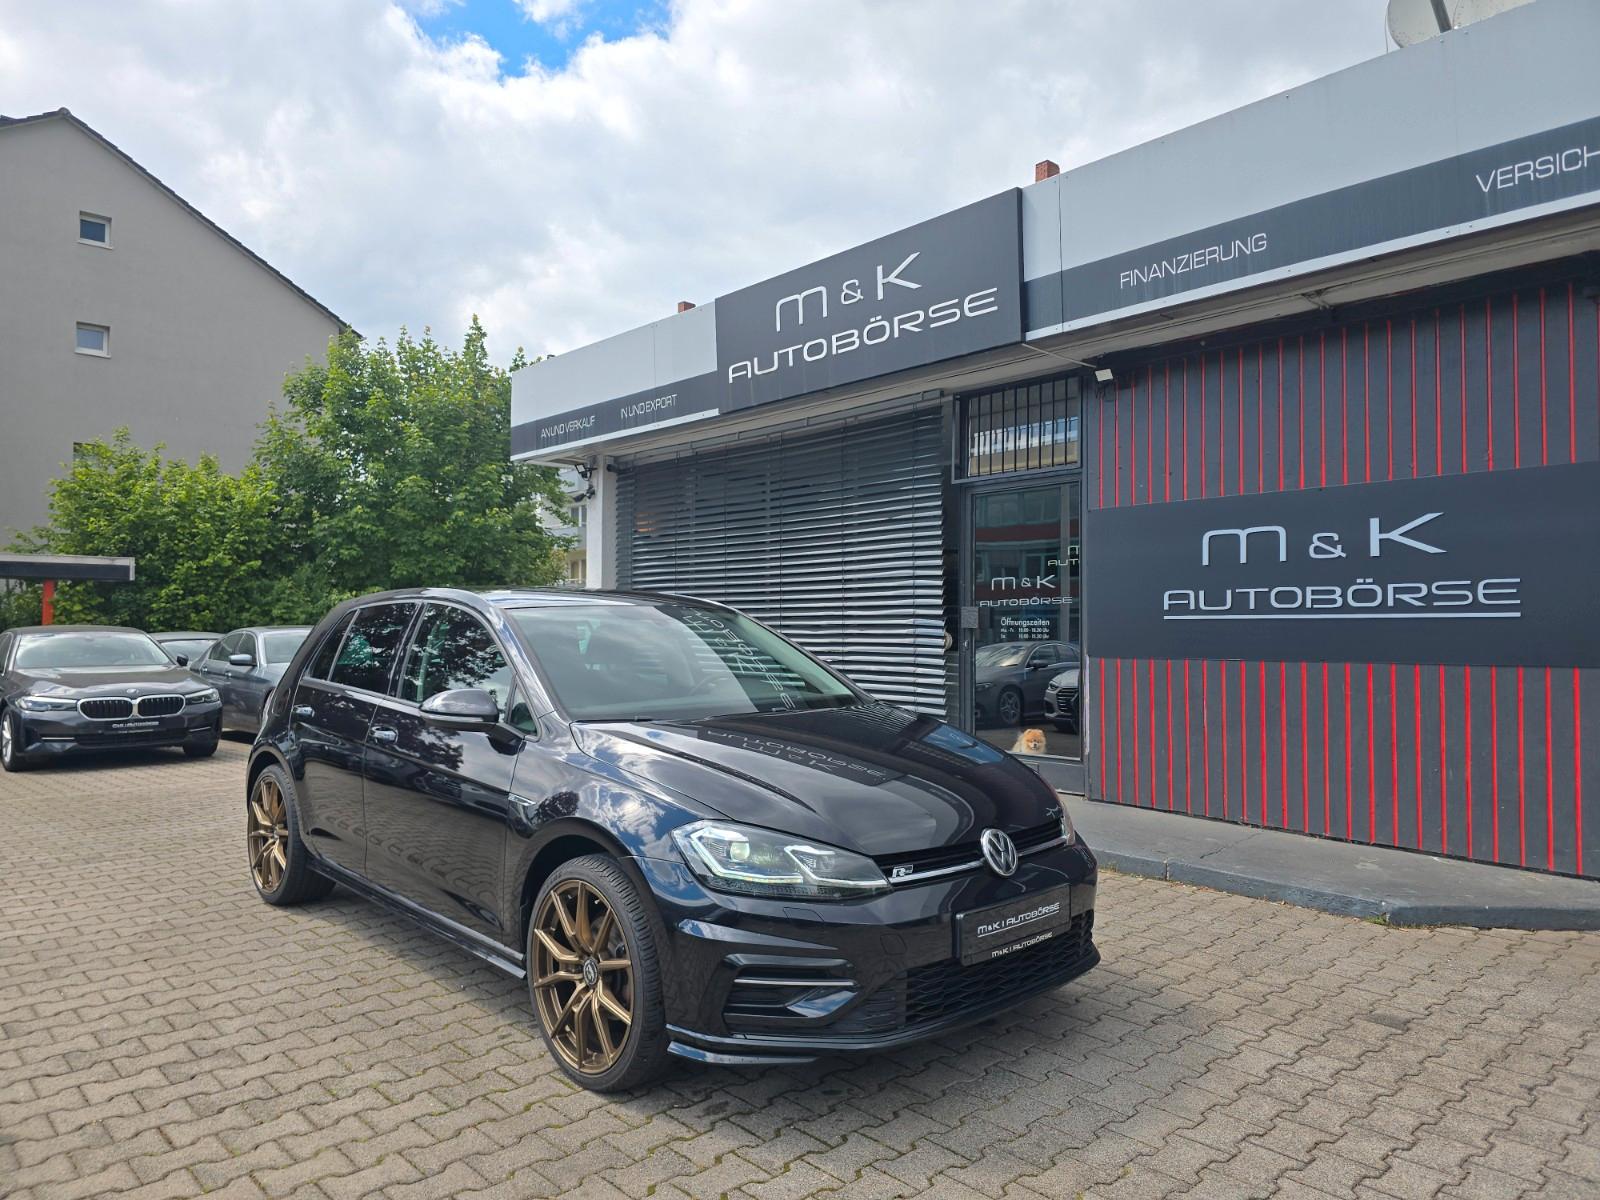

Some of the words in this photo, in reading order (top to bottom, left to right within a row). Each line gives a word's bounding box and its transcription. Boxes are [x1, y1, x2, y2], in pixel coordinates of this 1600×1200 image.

[1119, 232, 1268, 290] FINANZIERUNG
[775, 285, 829, 333] M
[840, 279, 865, 305] &
[876, 251, 923, 301] K
[728, 287, 999, 384] AUTOBÖRSE
[645, 394, 678, 413] EXPORT
[1202, 525, 1287, 566] M
[1308, 532, 1347, 559] &
[1369, 511, 1449, 557] K
[991, 576, 1016, 591] M
[1021, 577, 1032, 587] &
[1036, 574, 1056, 589] K
[1163, 577, 1522, 611] AUTOBÖRSE
[979, 596, 1073, 608] AUTOBÖRSE
[1006, 902, 1060, 926] AUTOBÖRSE
